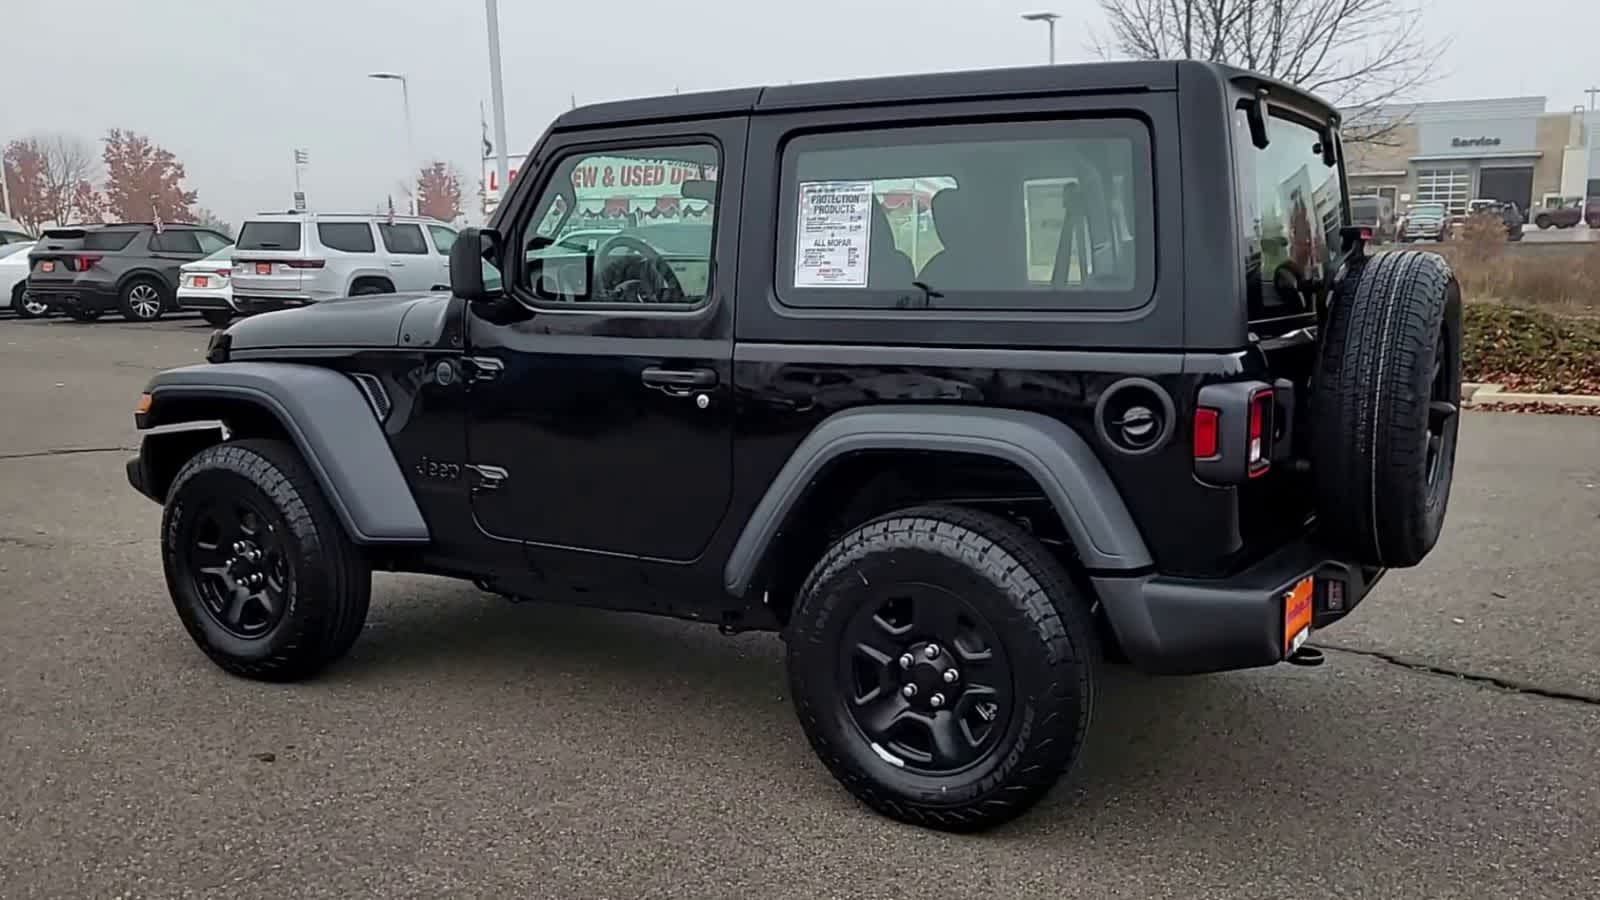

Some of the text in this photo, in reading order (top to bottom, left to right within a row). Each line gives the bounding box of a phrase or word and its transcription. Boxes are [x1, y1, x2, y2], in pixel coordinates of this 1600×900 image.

[1452, 136, 1501, 147] Service
[573, 165, 598, 188] EW
[602, 165, 615, 187] &
[621, 165, 665, 187] USED
[811, 194, 860, 205] PROTECTION
[813, 204, 856, 215] PRODUCTS
[813, 238, 852, 247] ALL MOPAR
